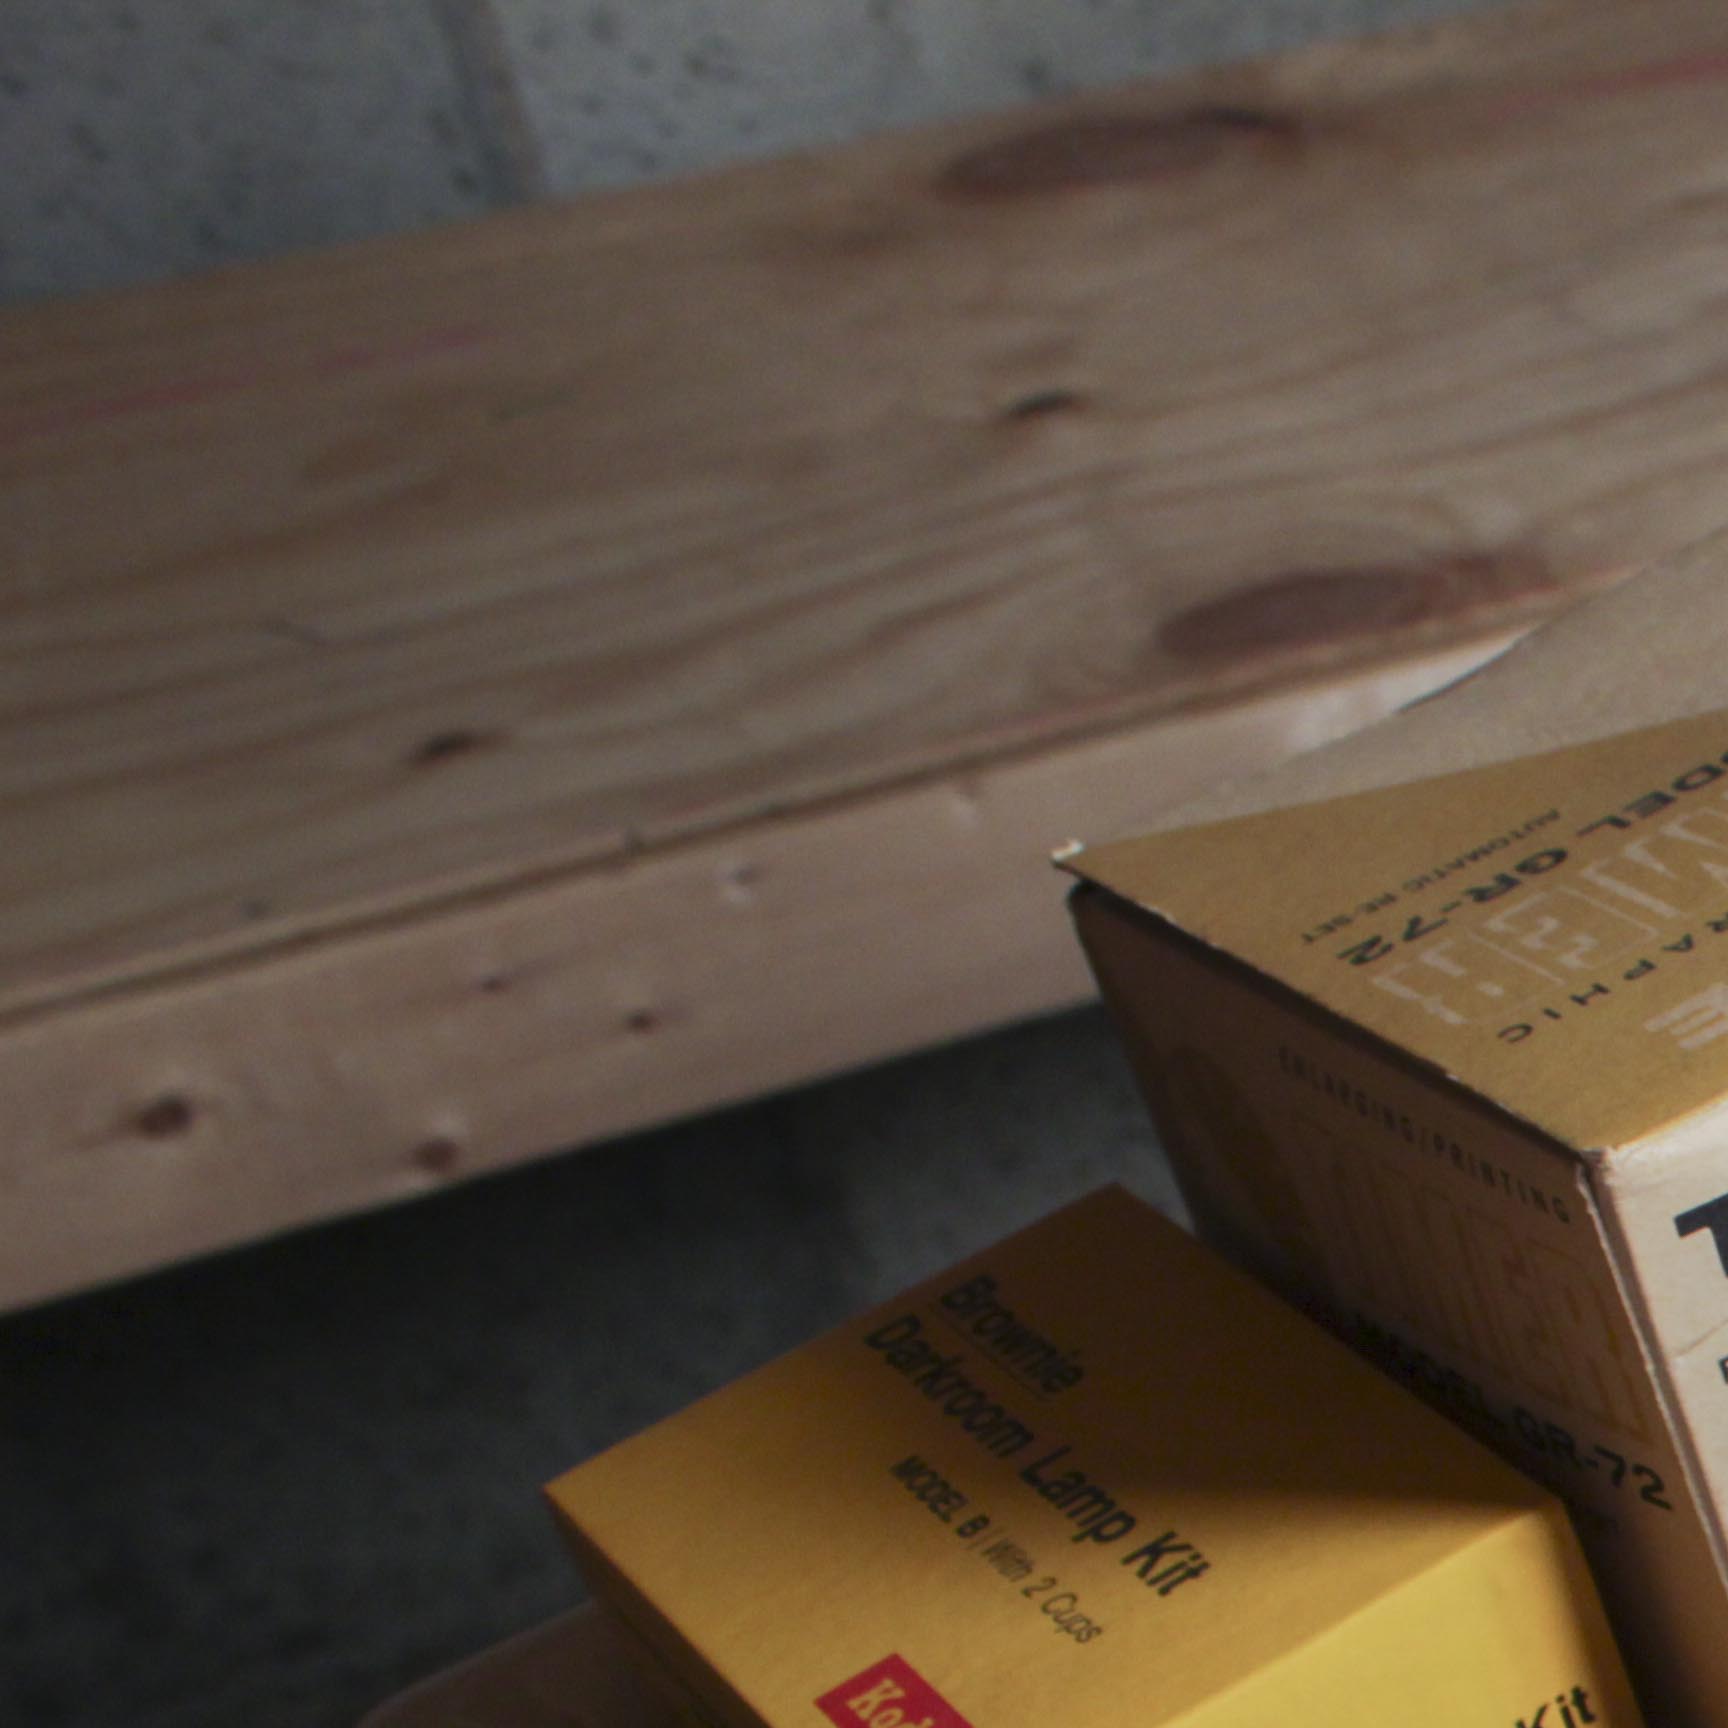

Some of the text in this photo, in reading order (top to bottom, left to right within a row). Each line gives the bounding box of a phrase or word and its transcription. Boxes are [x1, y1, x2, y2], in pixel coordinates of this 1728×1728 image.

[1336, 845, 1569, 968] GR-72
[941, 1273, 1084, 1394] Brownie
[863, 1313, 1211, 1598] Darkroom Lamp Kit
[1511, 1407, 1673, 1510] GR-72
[889, 1454, 969, 1524] MODEL
[956, 1513, 990, 1539] B
[1022, 1576, 1057, 1599] 2
[1040, 1593, 1104, 1645] Cups
